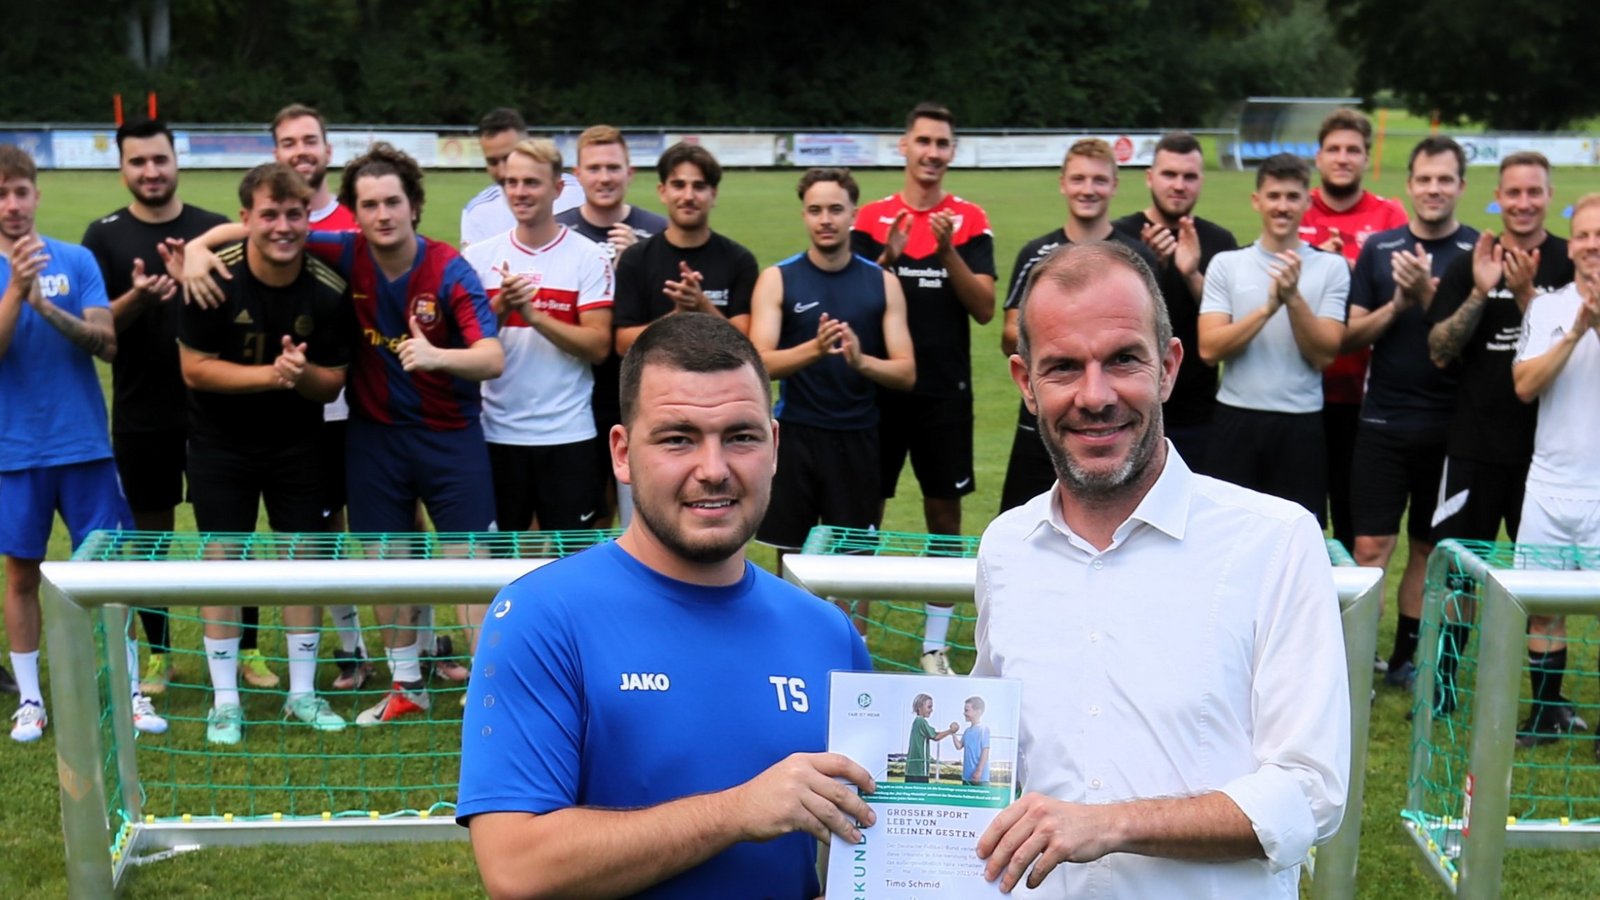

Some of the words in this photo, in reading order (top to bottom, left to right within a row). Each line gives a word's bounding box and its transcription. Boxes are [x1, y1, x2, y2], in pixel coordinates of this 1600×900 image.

[898, 266, 949, 278] Mercedes-B
[919, 278, 942, 288] Bank
[620, 673, 669, 691] JAKO
[769, 676, 809, 713] TS
[887, 808, 934, 817] GROSSER
[936, 810, 970, 819] SPORT
[886, 817, 913, 826] LEBT
[915, 819, 937, 827] VON
[886, 827, 933, 836] KLEINEN
[886, 880, 906, 888] Timo
[908, 880, 940, 889] Schmid
